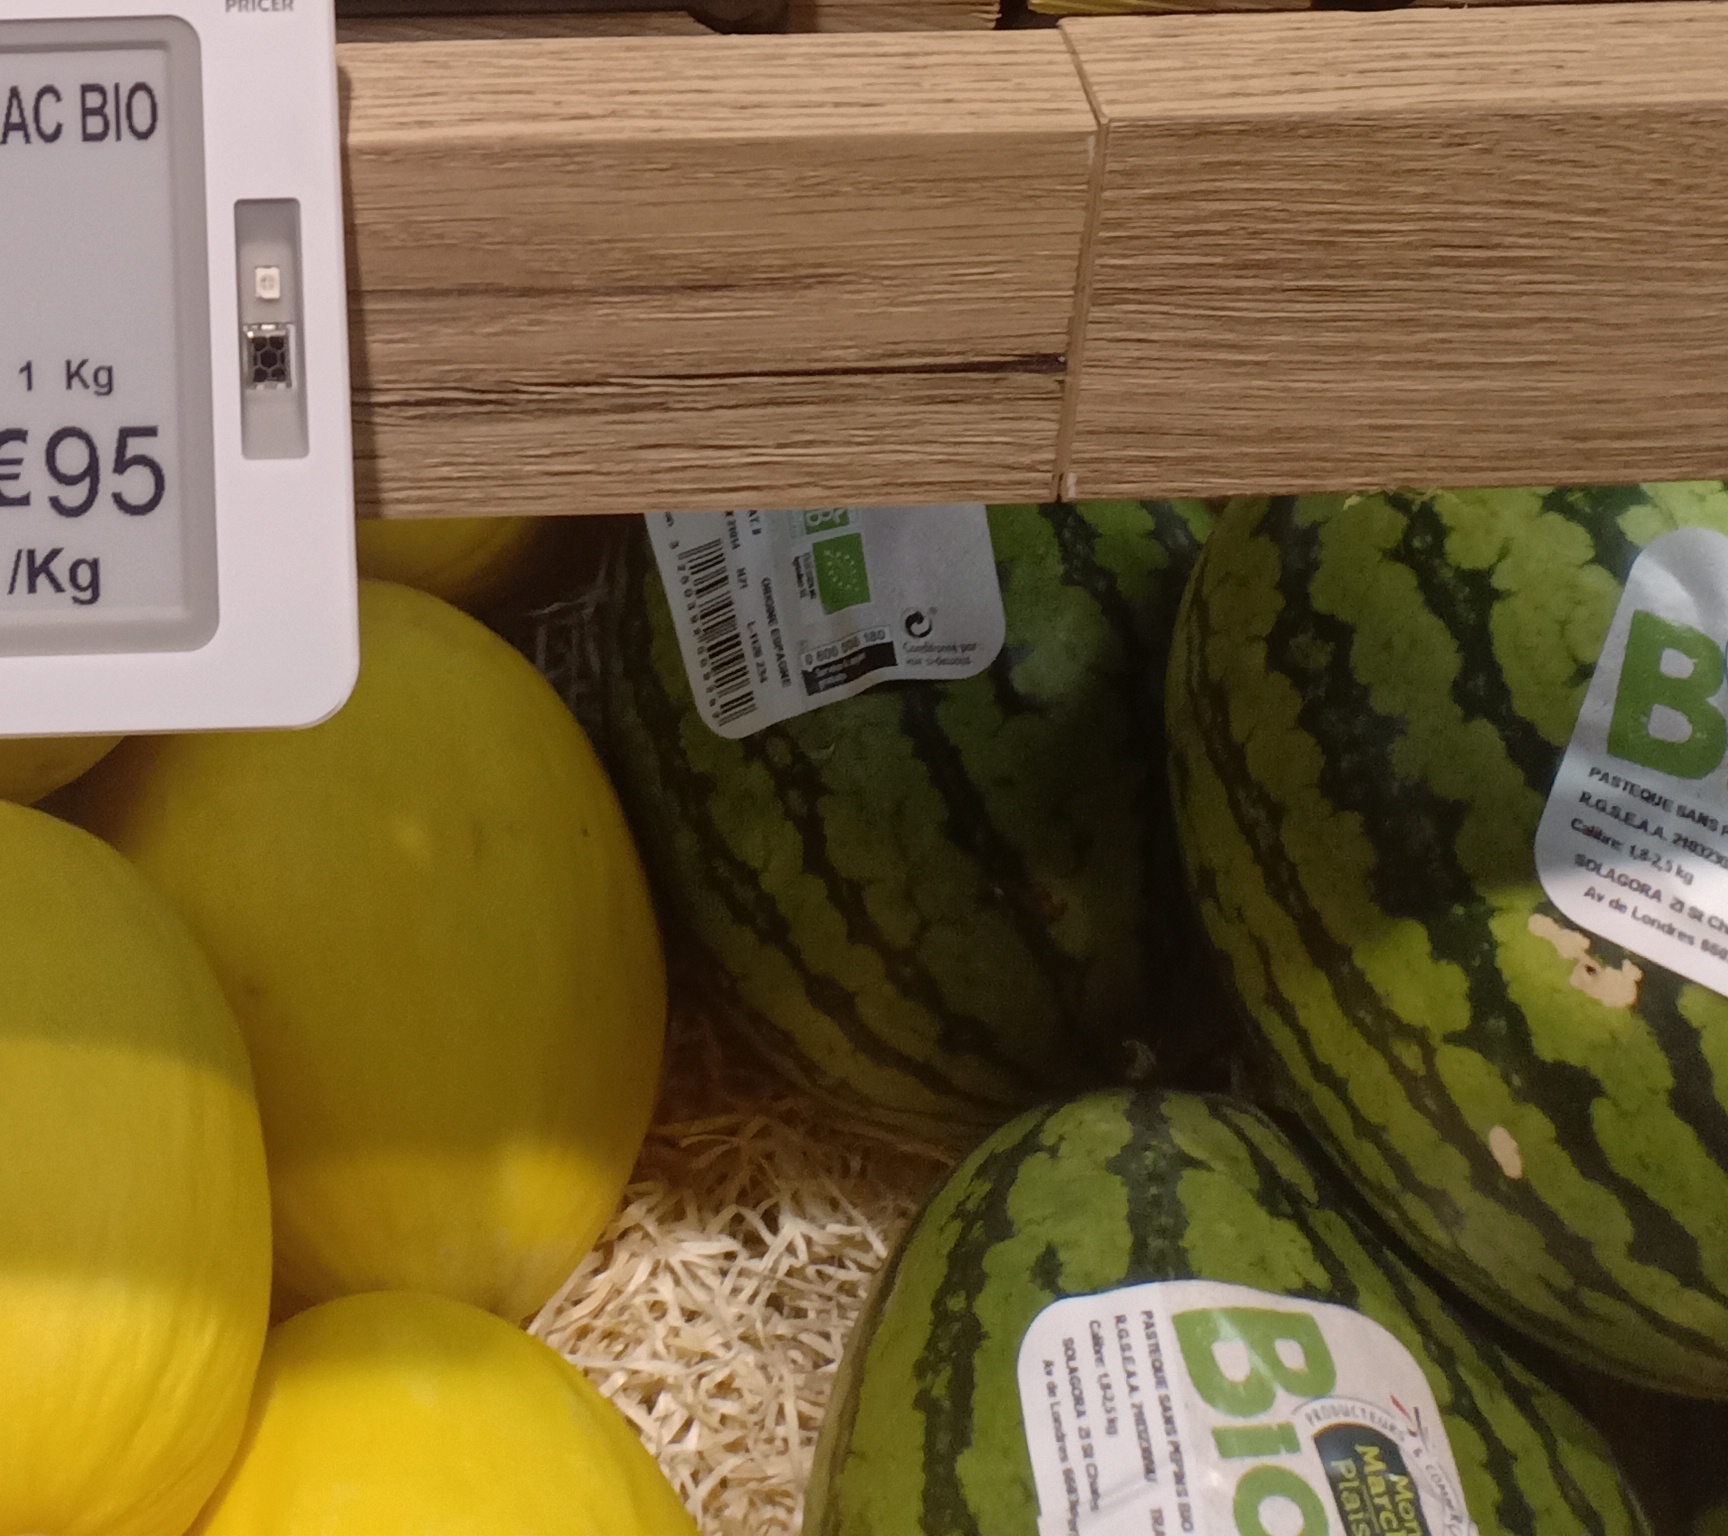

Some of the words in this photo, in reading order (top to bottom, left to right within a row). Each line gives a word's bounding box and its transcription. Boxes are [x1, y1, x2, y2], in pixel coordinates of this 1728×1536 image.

[80, 81, 159, 142] BIO
[18, 360, 34, 392] 1
[65, 358, 114, 397] Kg
[7, 547, 101, 606] /Kg
[1587, 766, 1674, 814] PASTEQUE
[1574, 852, 1663, 905] SOLAGORA
[1674, 863, 1696, 886] kg
[1583, 884, 1606, 905] Av
[1608, 894, 1628, 916] de
[1631, 904, 1697, 947] Londres
[1062, 1337, 1085, 1420] SOLAGORA
[1141, 1309, 1169, 1393] PASTEQUE
[1354, 1444, 1409, 1536] Marc
